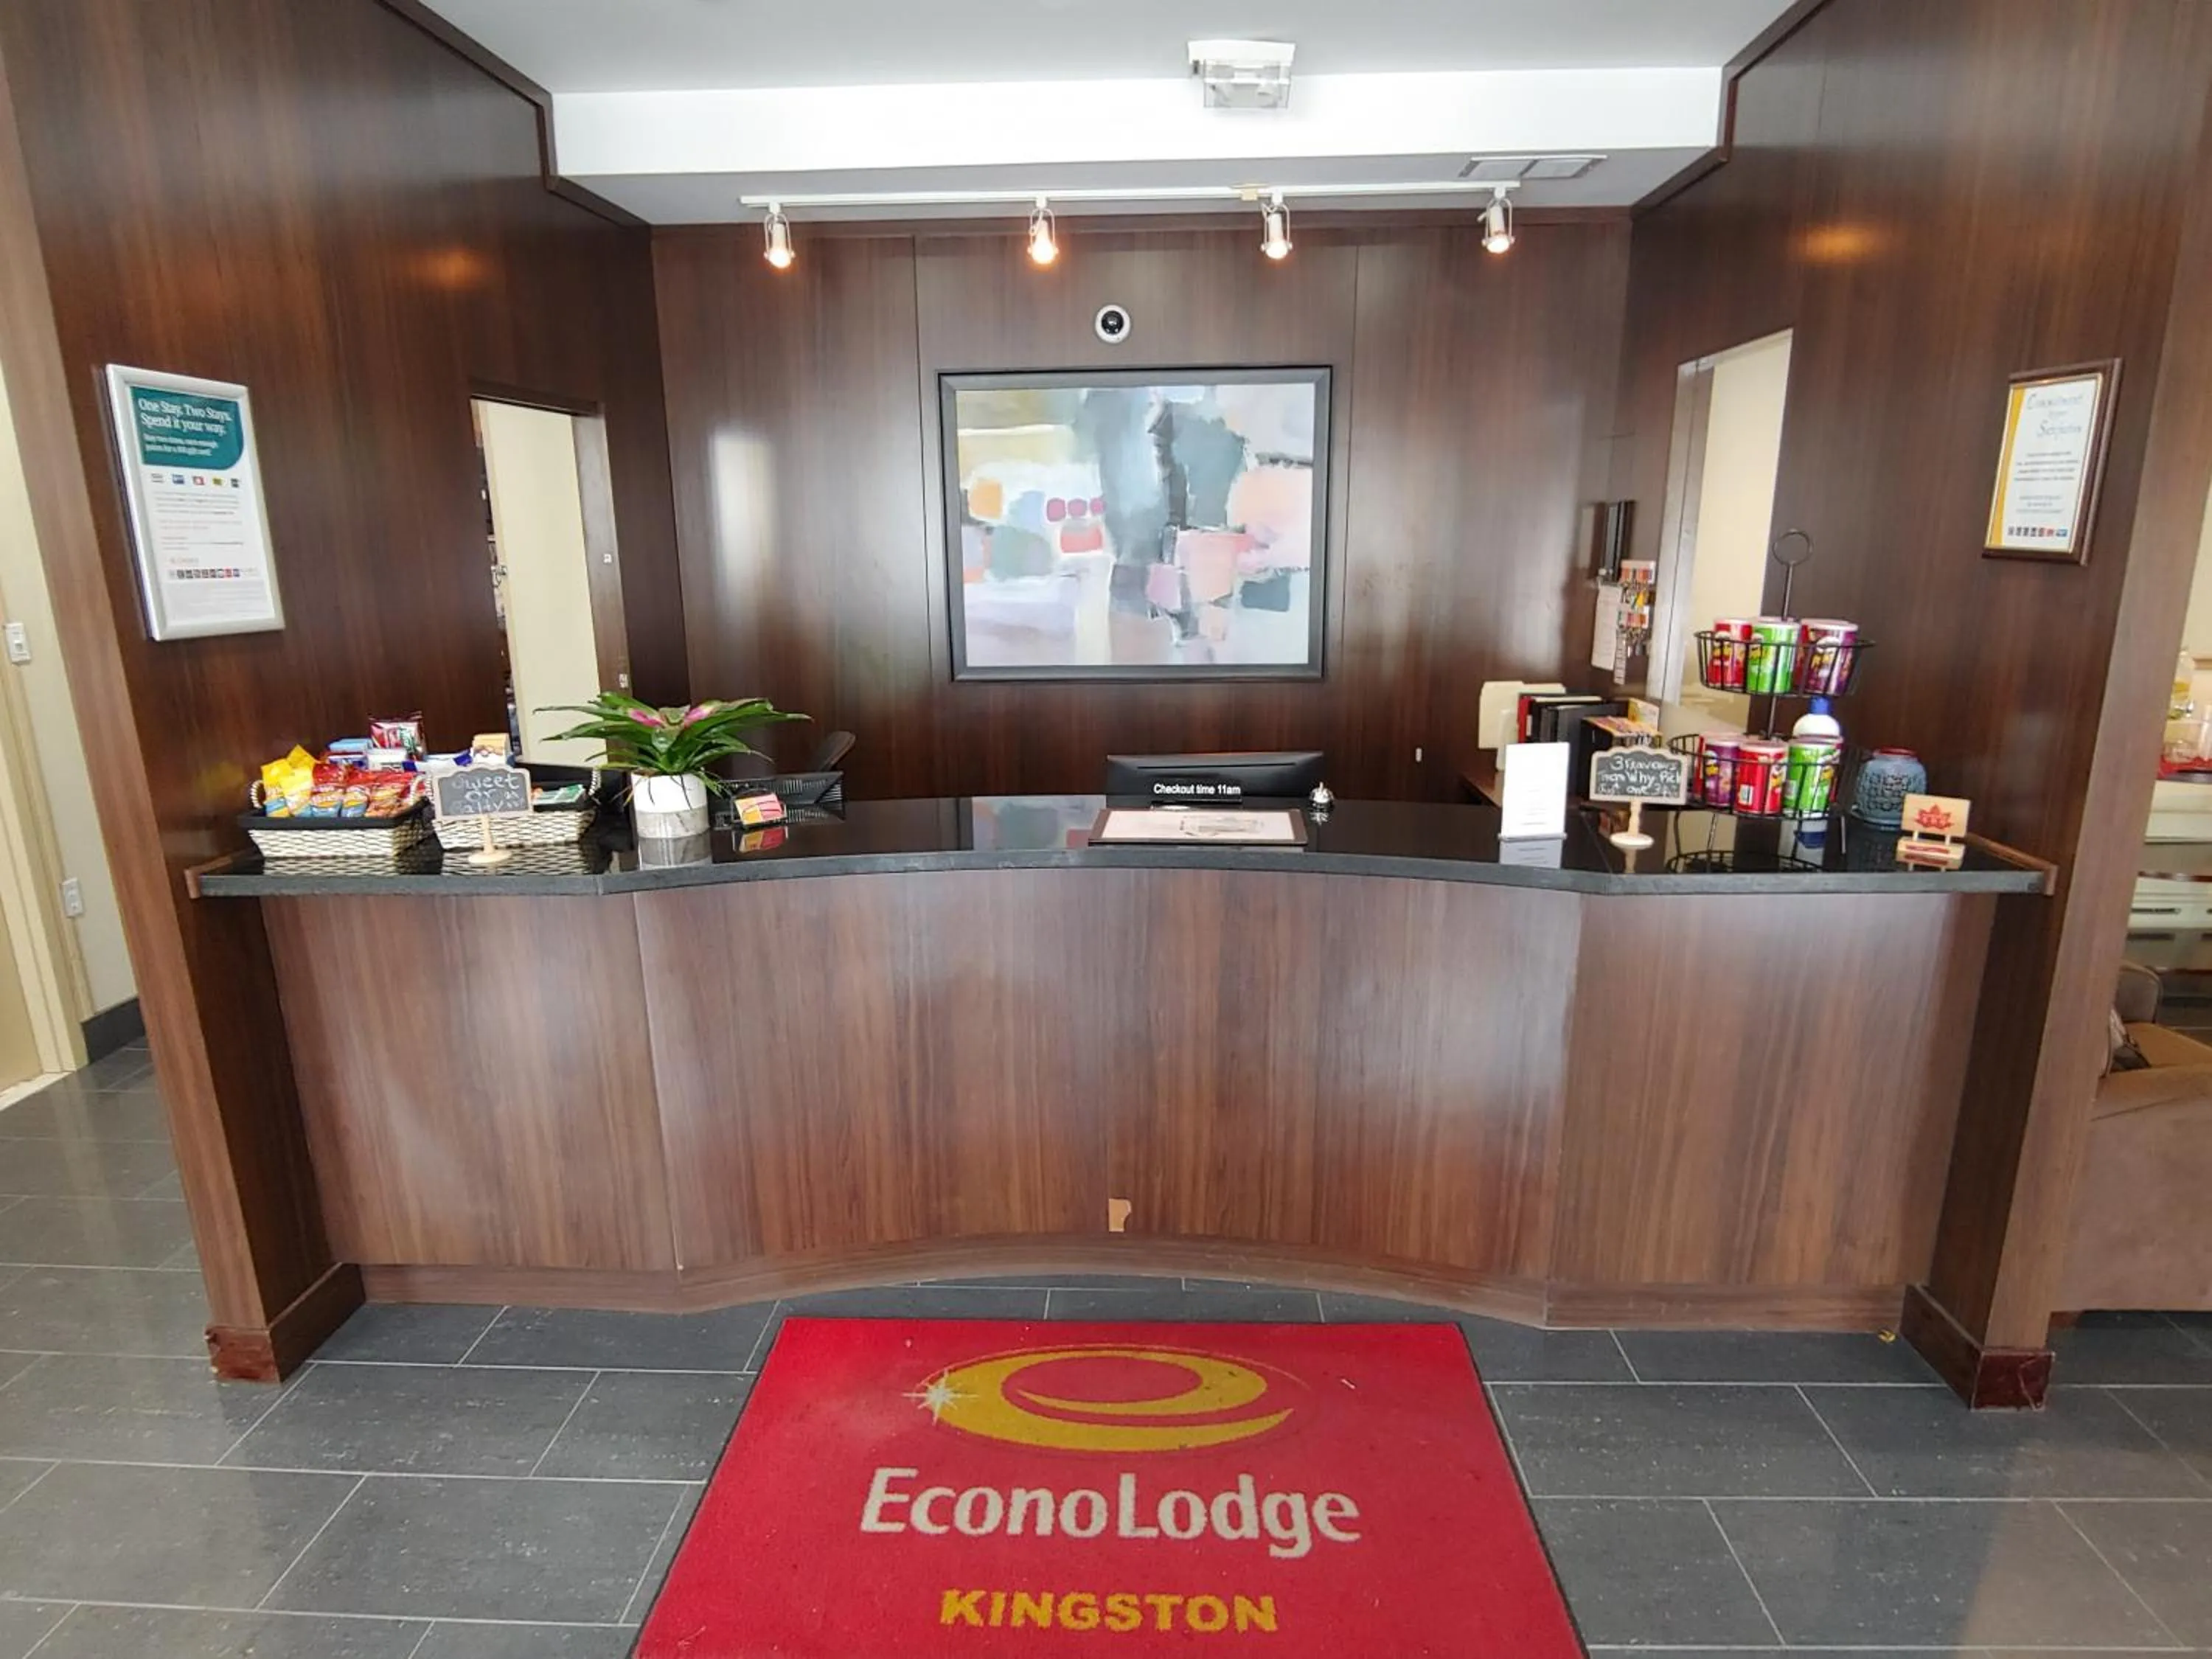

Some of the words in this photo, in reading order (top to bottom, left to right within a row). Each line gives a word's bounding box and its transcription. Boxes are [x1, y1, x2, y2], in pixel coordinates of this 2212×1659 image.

[138, 397, 159, 412] One
[184, 403, 205, 418] Two
[140, 412, 171, 431] Spend
[172, 416, 181, 428] it
[181, 420, 204, 433] your
[1625, 769, 1656, 787] Why
[1153, 783, 1195, 795] Checkout
[1197, 783, 1215, 795] time
[1217, 783, 1242, 795] 11am
[939, 1588, 1279, 1632] KINGSTON
